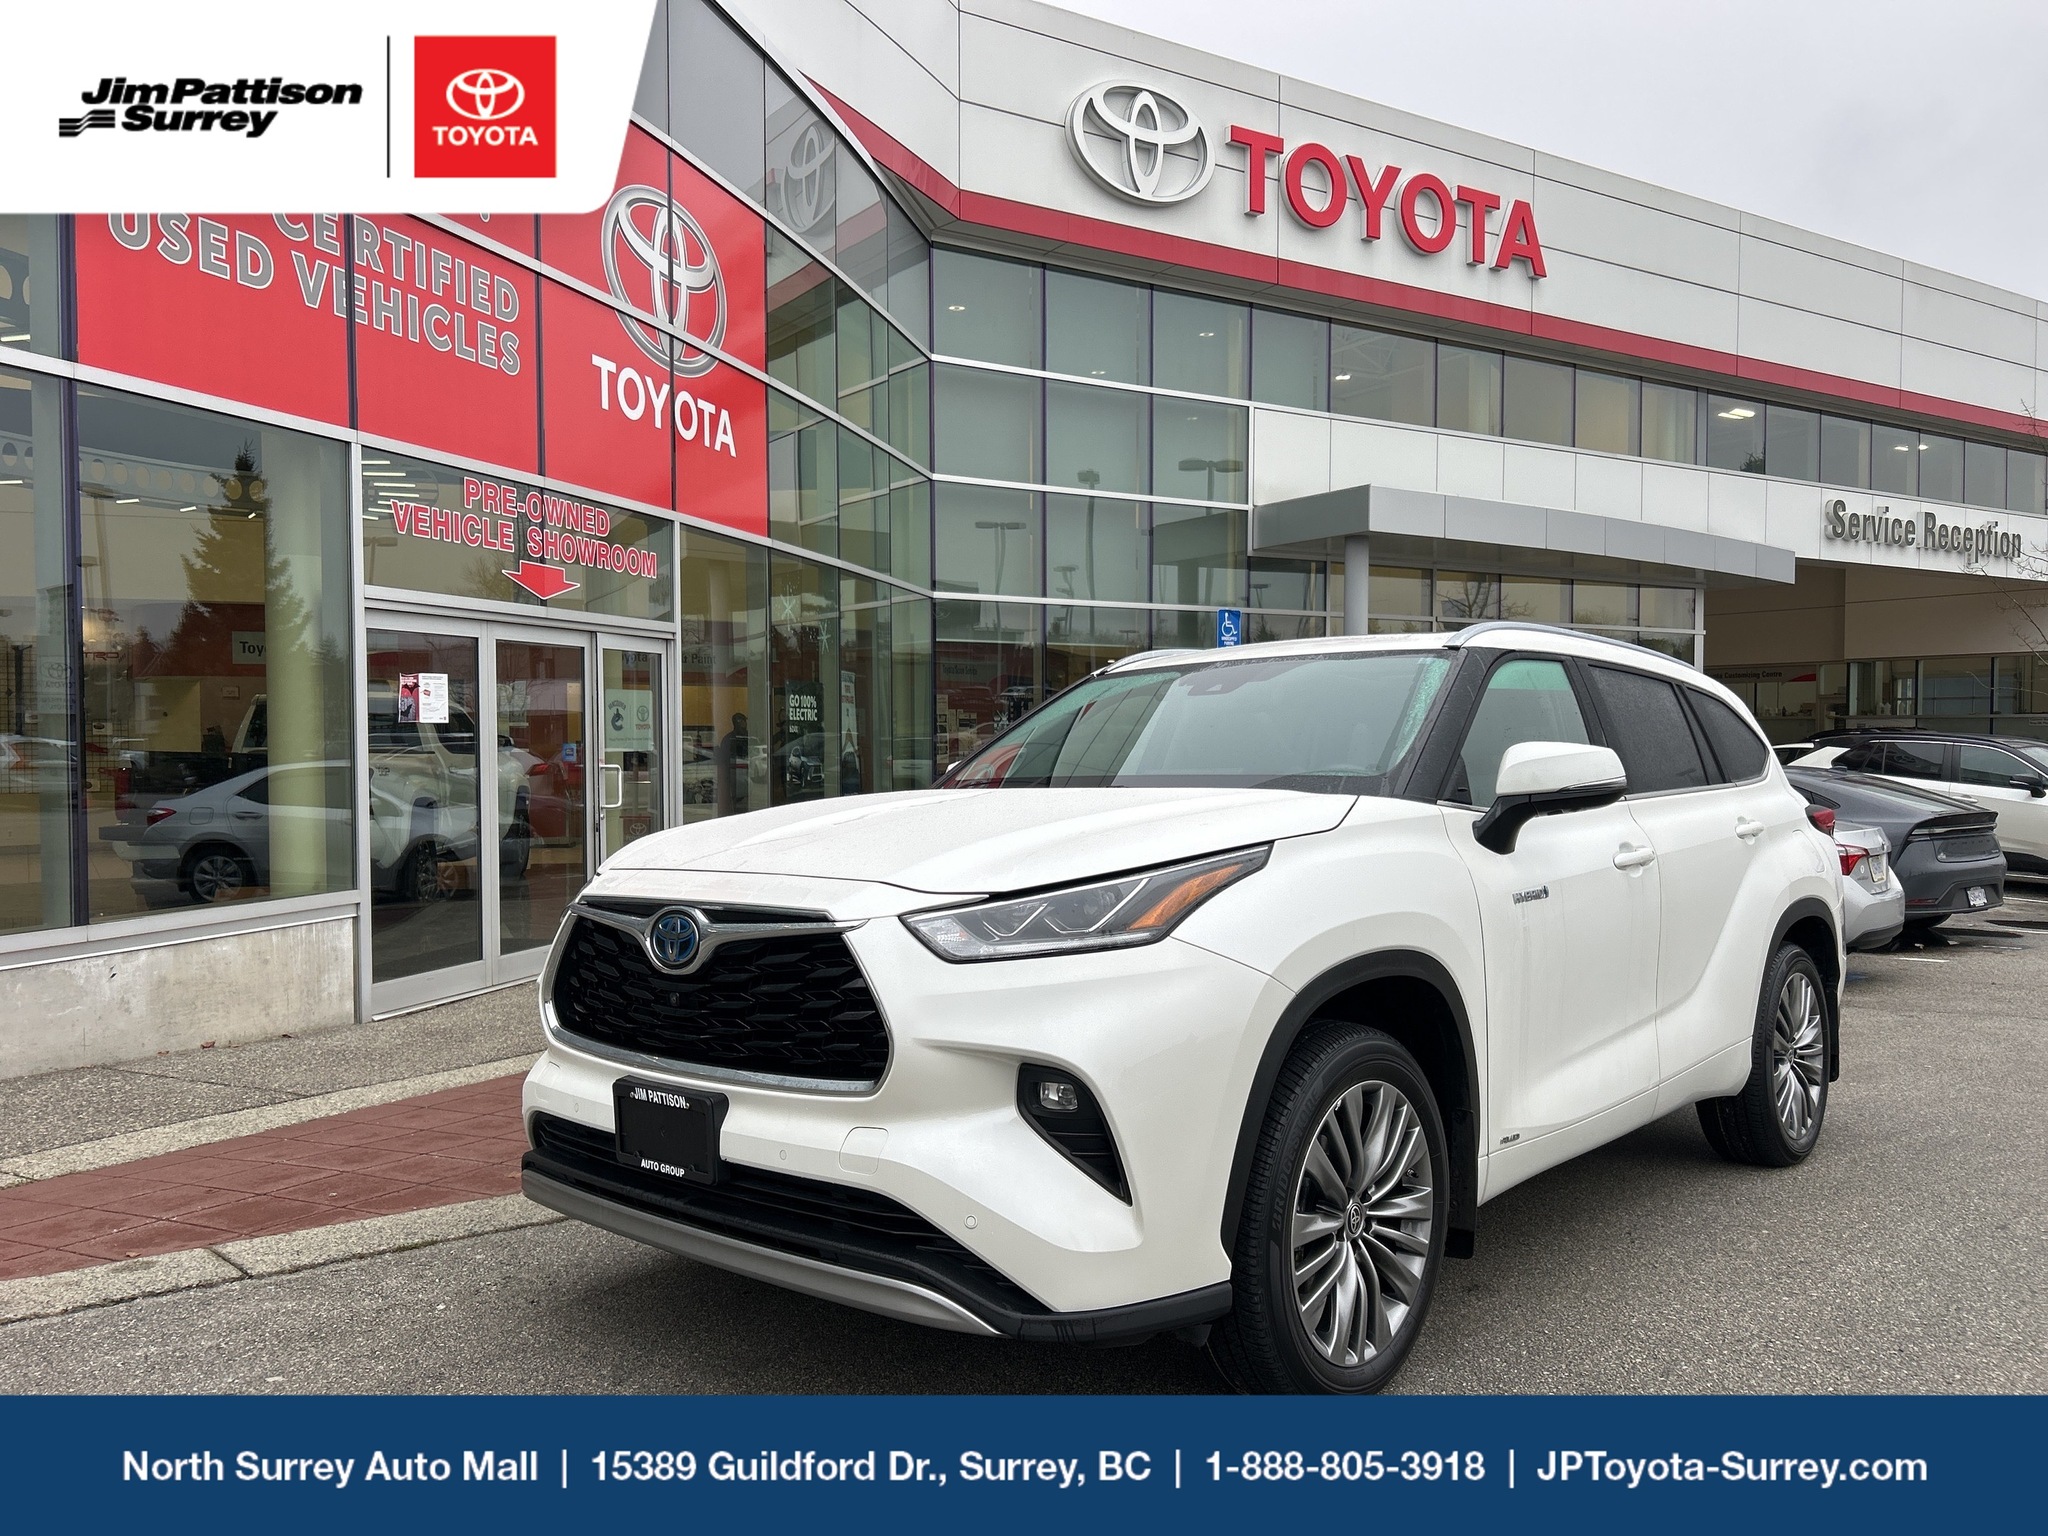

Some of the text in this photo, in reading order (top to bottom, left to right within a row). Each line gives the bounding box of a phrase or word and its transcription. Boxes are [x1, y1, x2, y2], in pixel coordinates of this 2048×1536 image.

[1224, 124, 1548, 280] TOYOTA
[108, 213, 521, 376] USED VEHICLES
[591, 354, 737, 458] TOYOTA
[464, 476, 611, 537] PRE-OWNED
[390, 499, 657, 578] VEHICLE SHOWROOM
[1825, 499, 2022, 566] Service Reception
[239, 641, 266, 657] Toy
[622, 653, 648, 665] yota
[789, 694, 800, 708] GO
[789, 708, 818, 721] ELECTRIC
[634, 1087, 687, 1109] JIM PATTISON
[641, 1158, 685, 1178] AUTO GROUP
